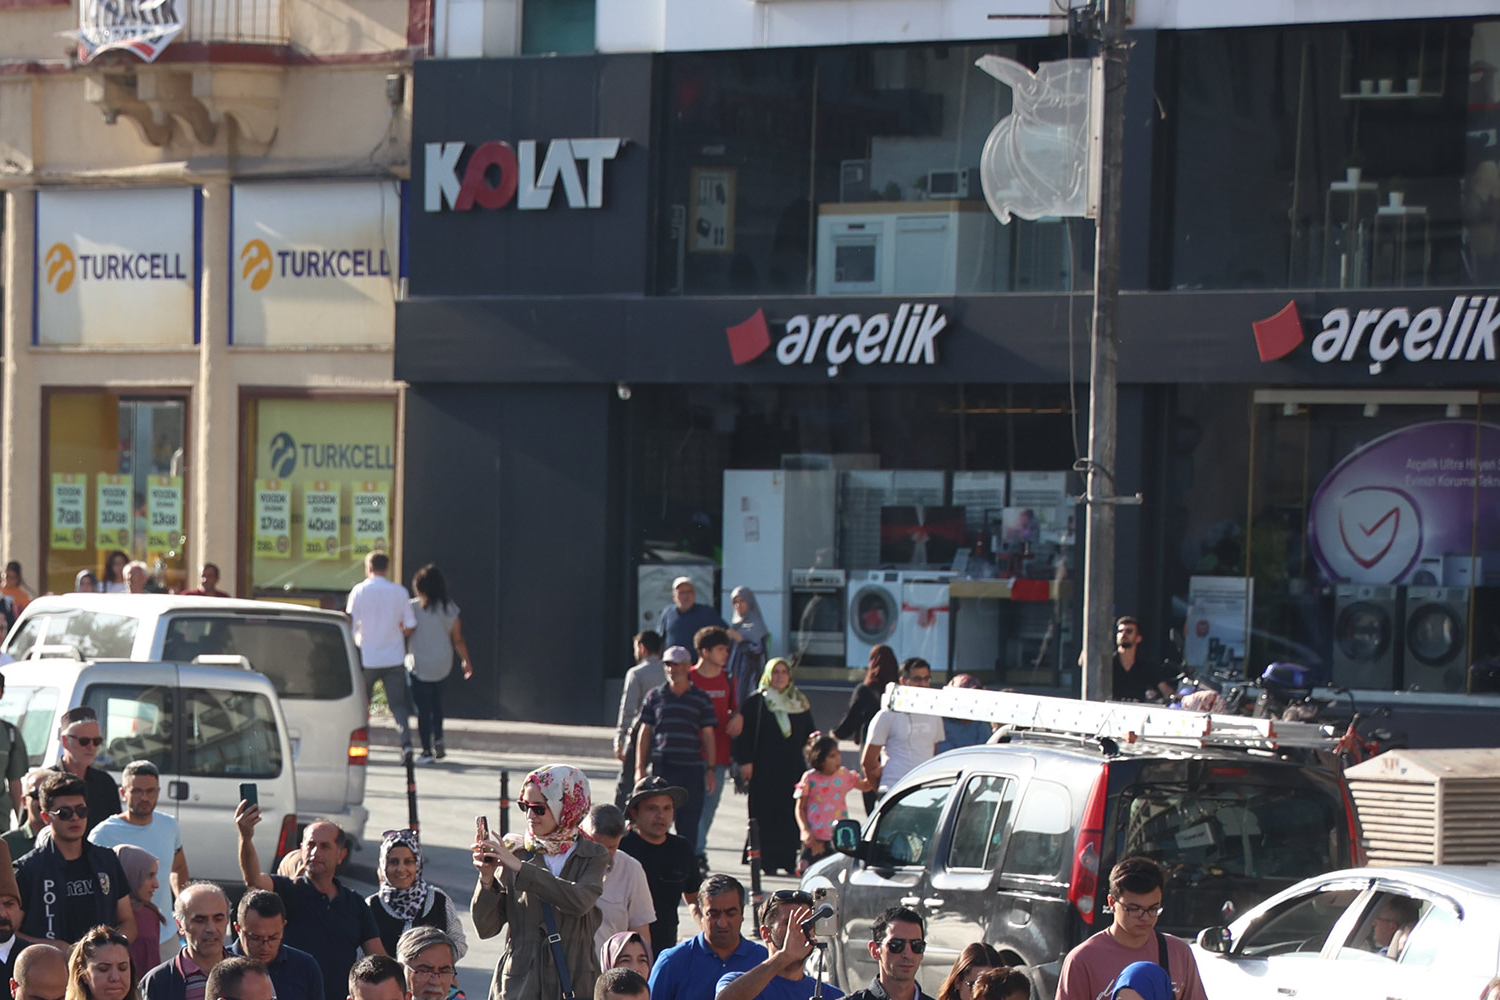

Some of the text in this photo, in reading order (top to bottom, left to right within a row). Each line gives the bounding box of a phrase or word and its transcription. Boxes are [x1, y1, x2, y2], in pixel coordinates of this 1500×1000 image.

[79, 253, 187, 280] TURKCELL
[277, 249, 390, 278] TURKCELL
[775, 303, 947, 378] arçelik
[1311, 295, 1500, 375] arçelik
[301, 443, 394, 470] TURKCELL
